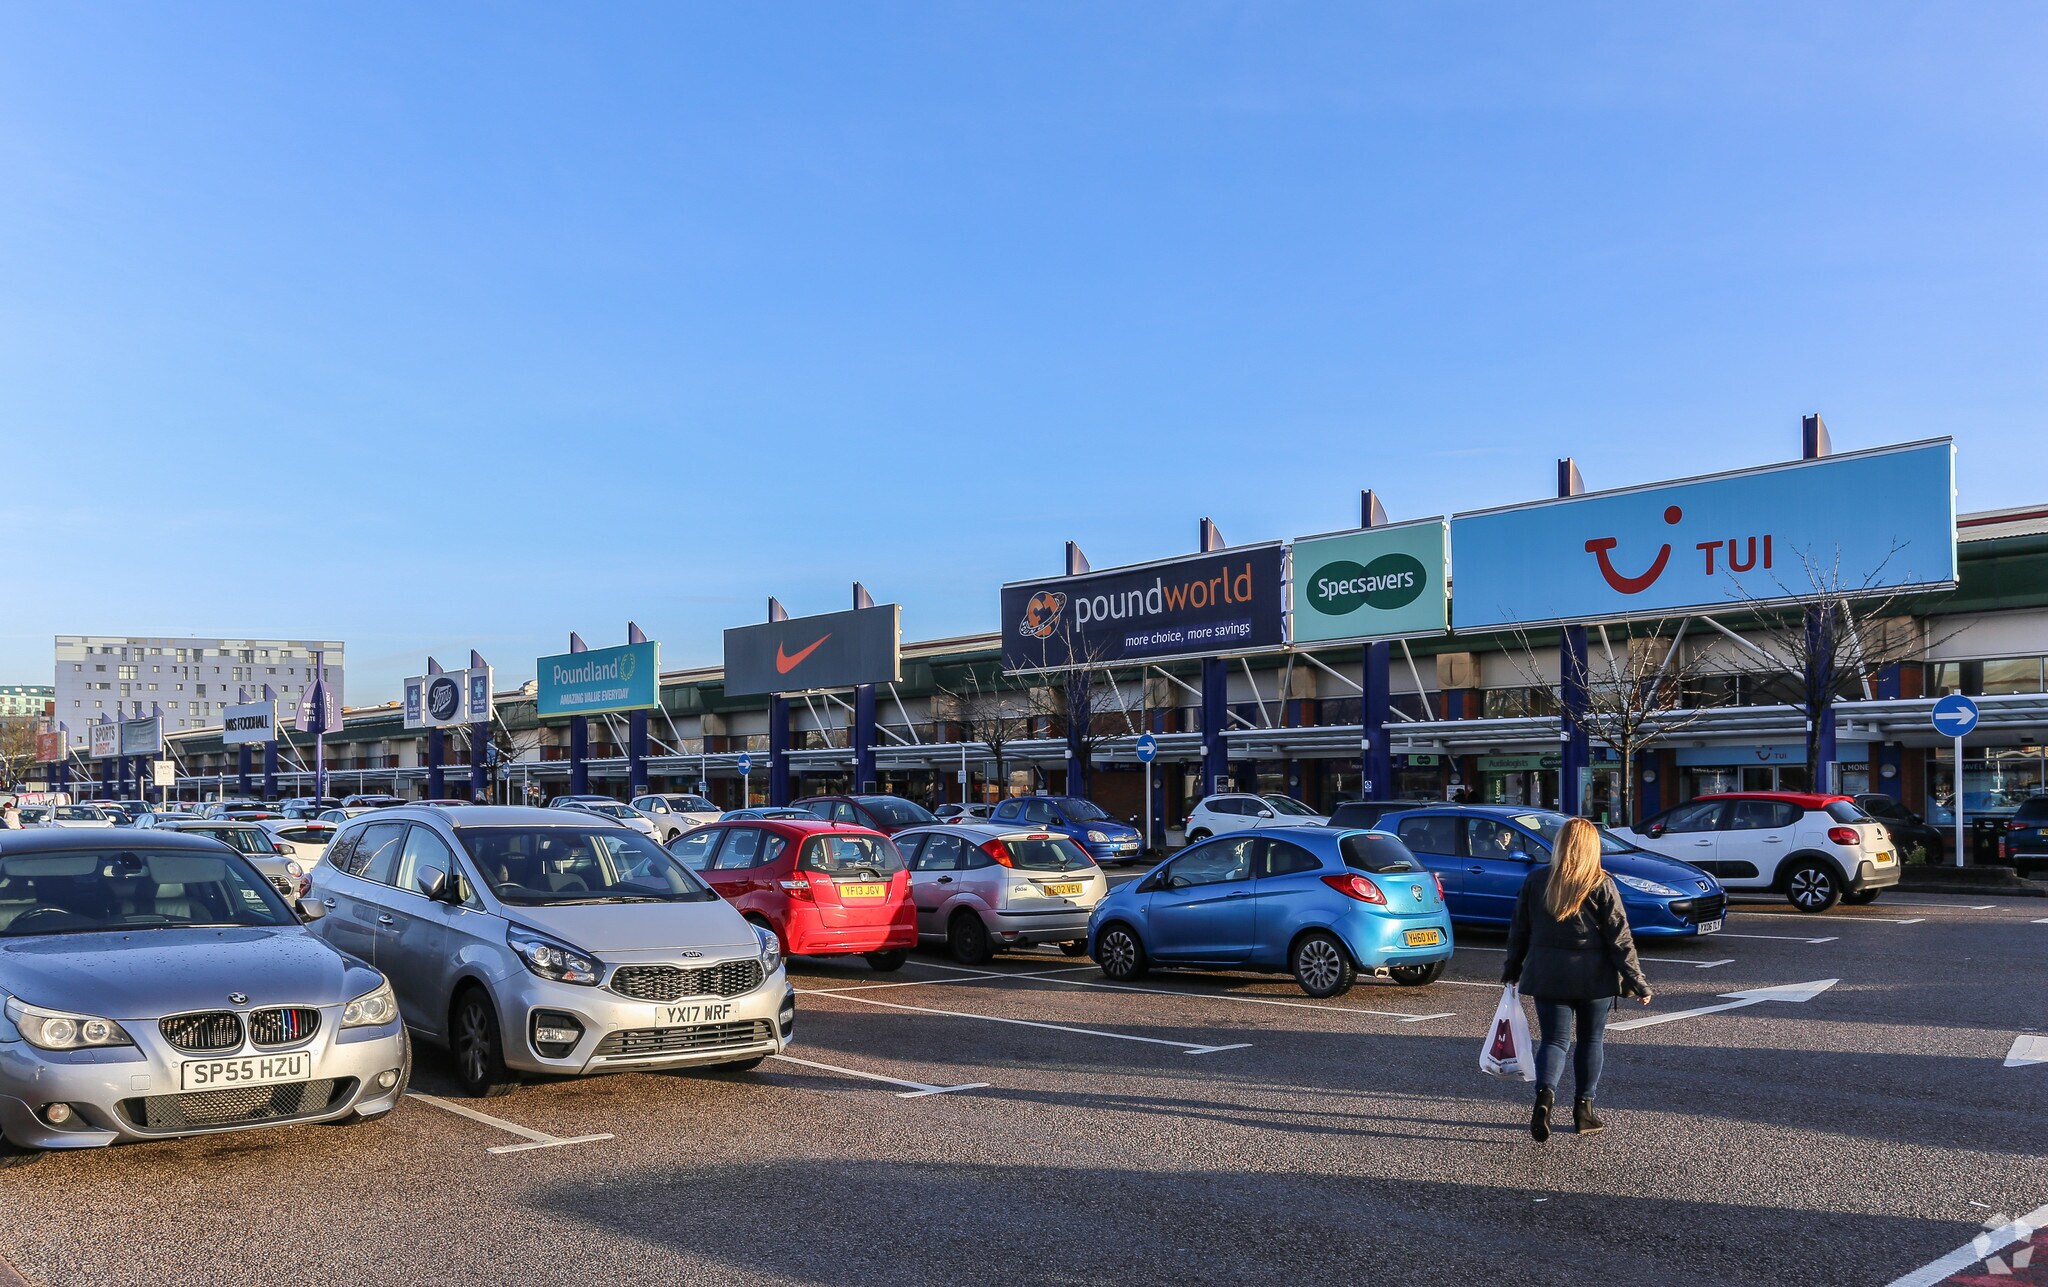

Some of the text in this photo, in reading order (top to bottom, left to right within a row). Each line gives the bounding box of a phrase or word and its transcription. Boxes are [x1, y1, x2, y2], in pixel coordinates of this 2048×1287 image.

[1696, 534, 1772, 576] TUI
[1318, 571, 1414, 601] Specsavers
[1075, 563, 1252, 633] poundworld
[1125, 622, 1250, 647] more choice, more savings
[553, 658, 618, 686] Poundland
[431, 685, 452, 713] Boots
[560, 687, 629, 706] AMAZING VALUE EVERYDAY
[238, 714, 269, 730] FOODHALL
[95, 725, 116, 743] SPORTS
[1488, 759, 1529, 769] Audiologists
[845, 885, 880, 895] YF13 JGV
[1066, 884, 1080, 894] VEV
[1408, 931, 1437, 944] YH60 XVP
[667, 1003, 732, 1023] YX17 WRF
[194, 1056, 301, 1084] SP55 HZU
